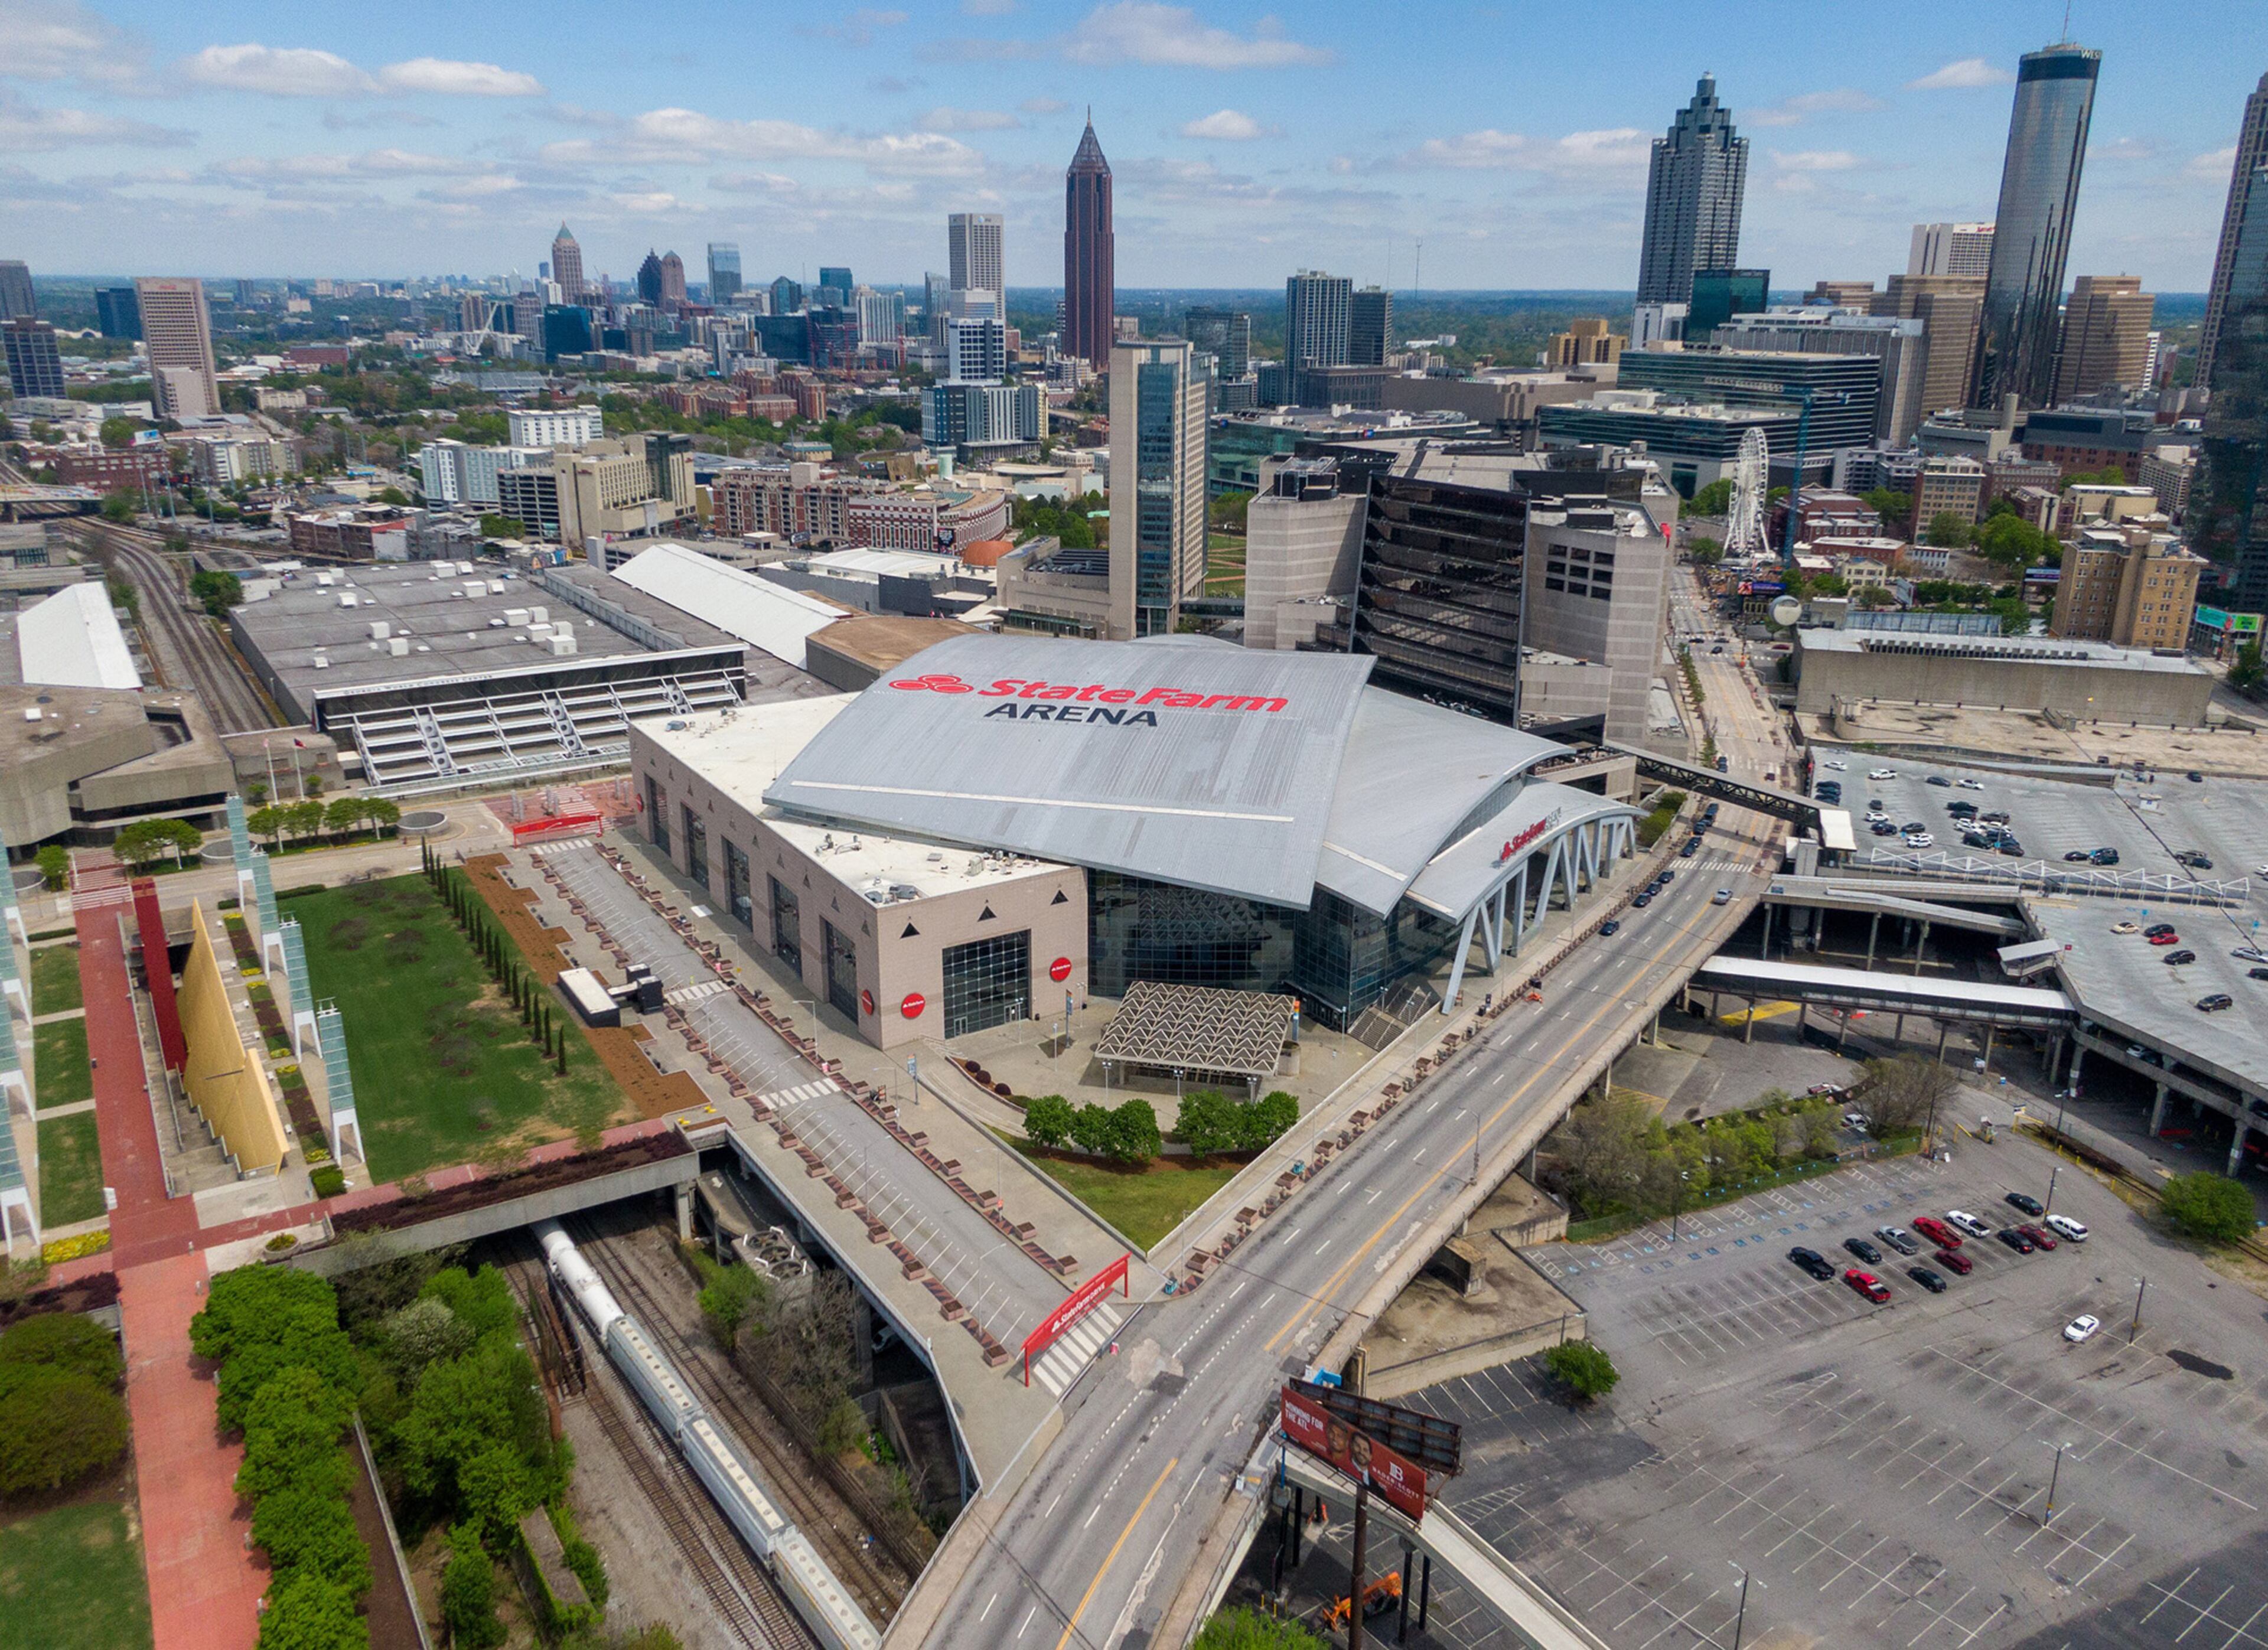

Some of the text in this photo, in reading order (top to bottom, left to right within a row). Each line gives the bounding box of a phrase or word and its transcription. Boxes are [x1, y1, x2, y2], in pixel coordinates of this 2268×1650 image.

[984, 703, 1158, 726] ARENA
[1285, 1408, 1296, 1424] THE
[1311, 1416, 1324, 1431] FOR
